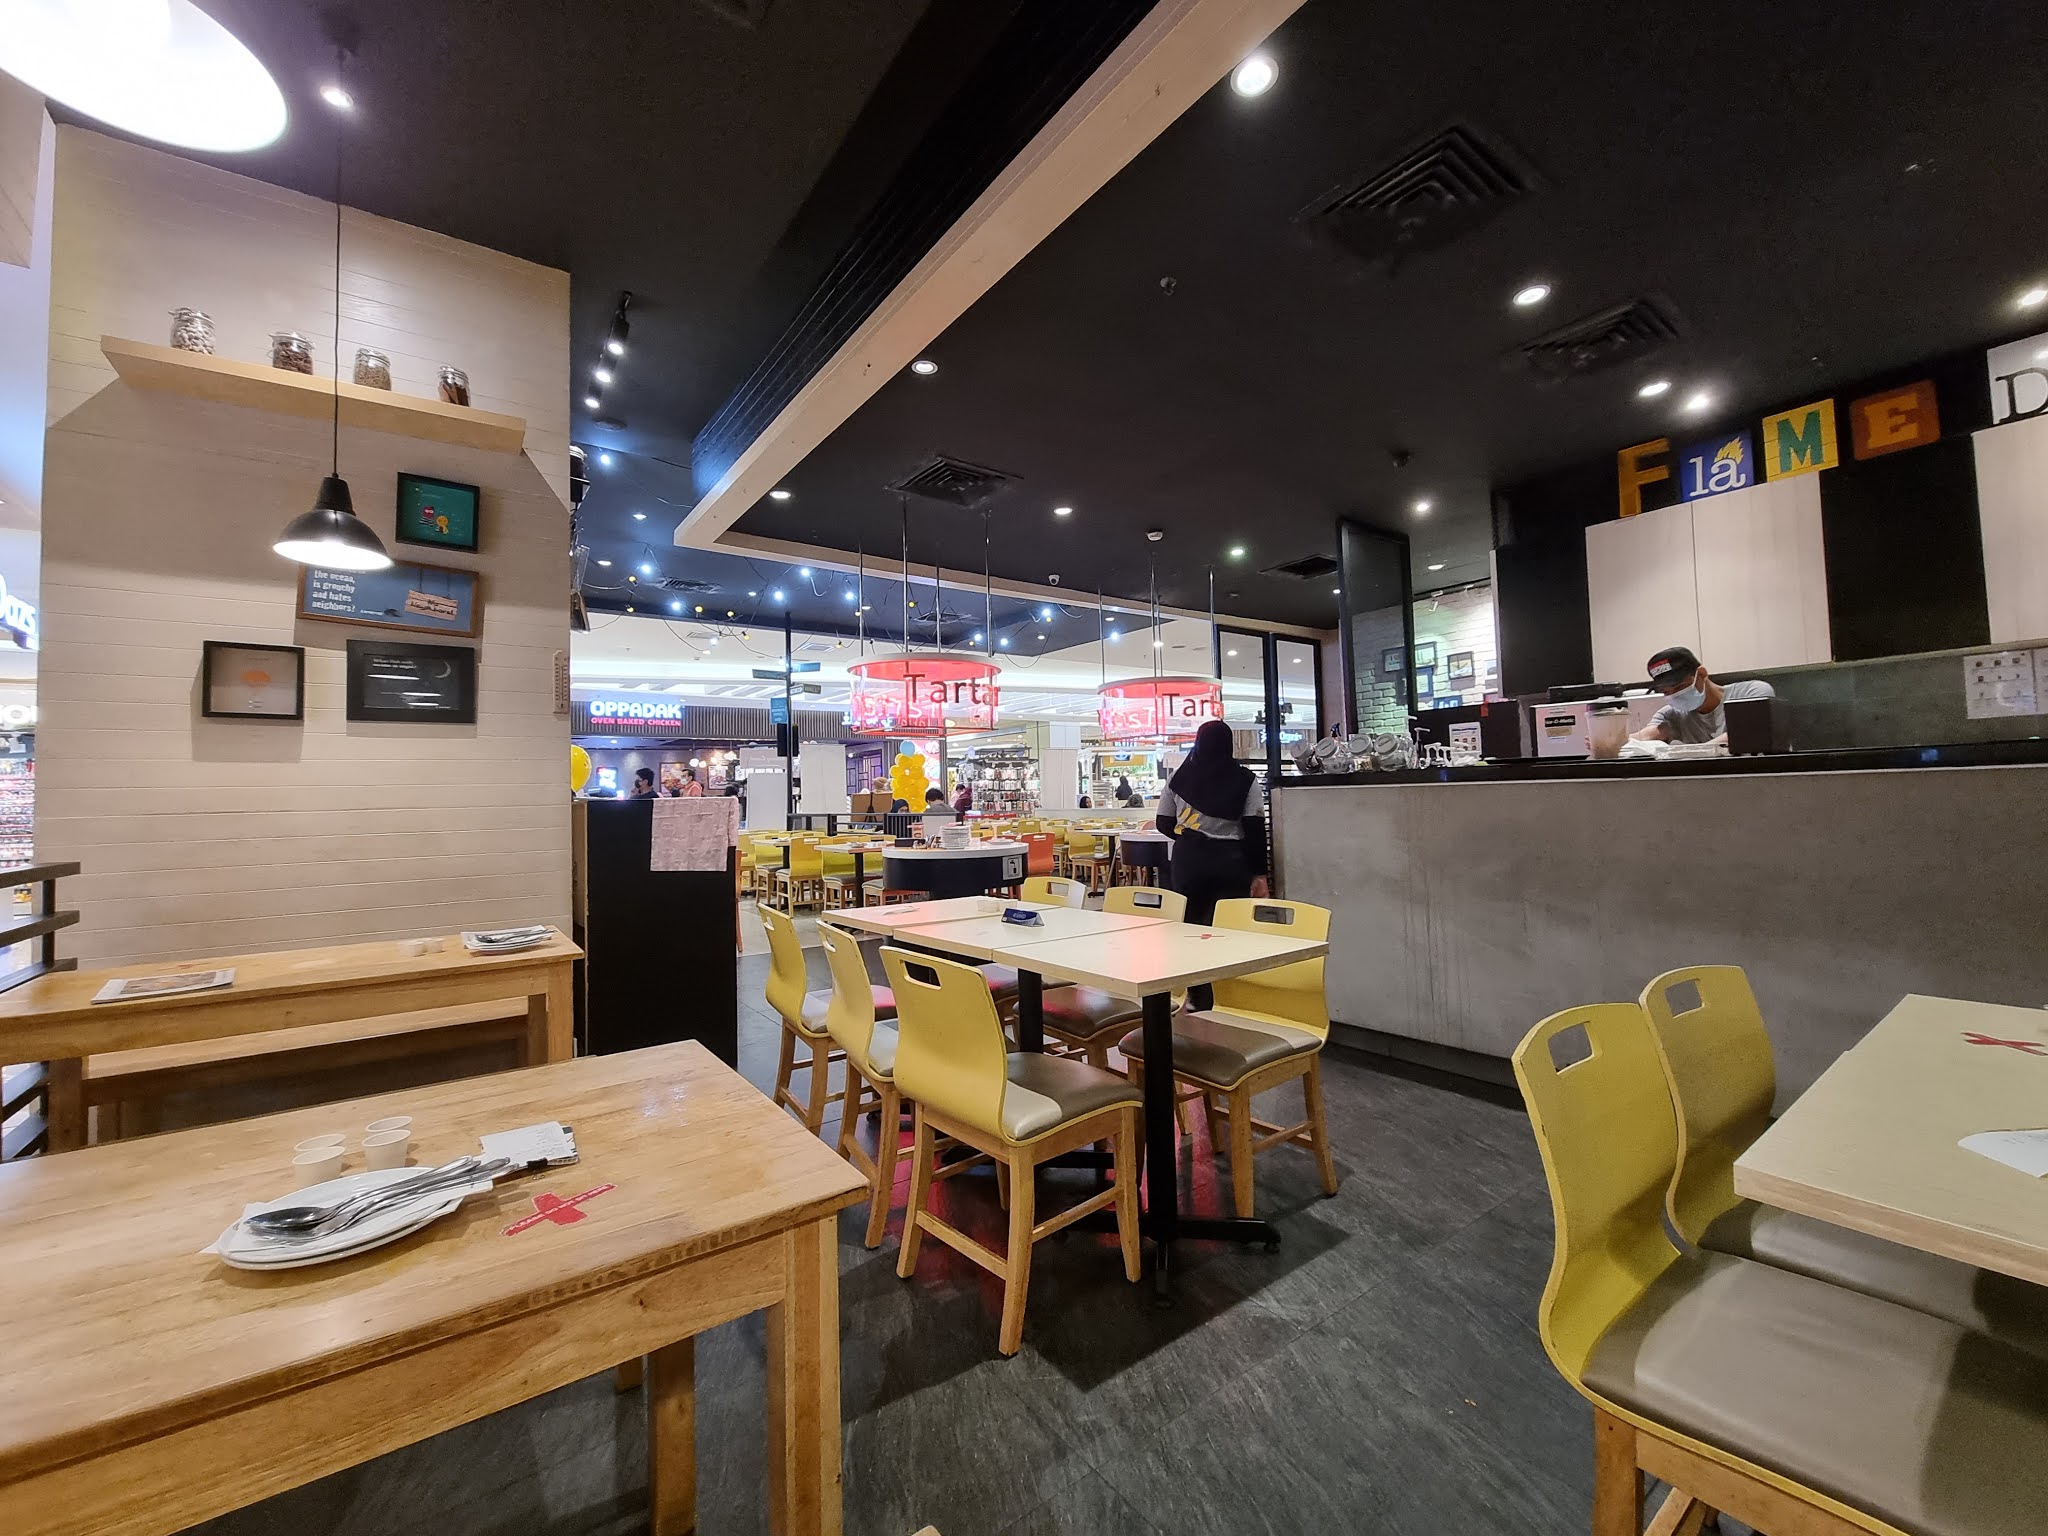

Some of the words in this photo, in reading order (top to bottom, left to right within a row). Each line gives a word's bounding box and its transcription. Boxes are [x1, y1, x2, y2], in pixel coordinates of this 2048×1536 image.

[314, 570, 328, 579] the
[329, 573, 355, 584] ocean,
[313, 580, 321, 588] is
[322, 582, 356, 593] grouchy
[312, 591, 328, 599] and
[329, 591, 352, 602] hates
[590, 700, 682, 719] OPPADAK
